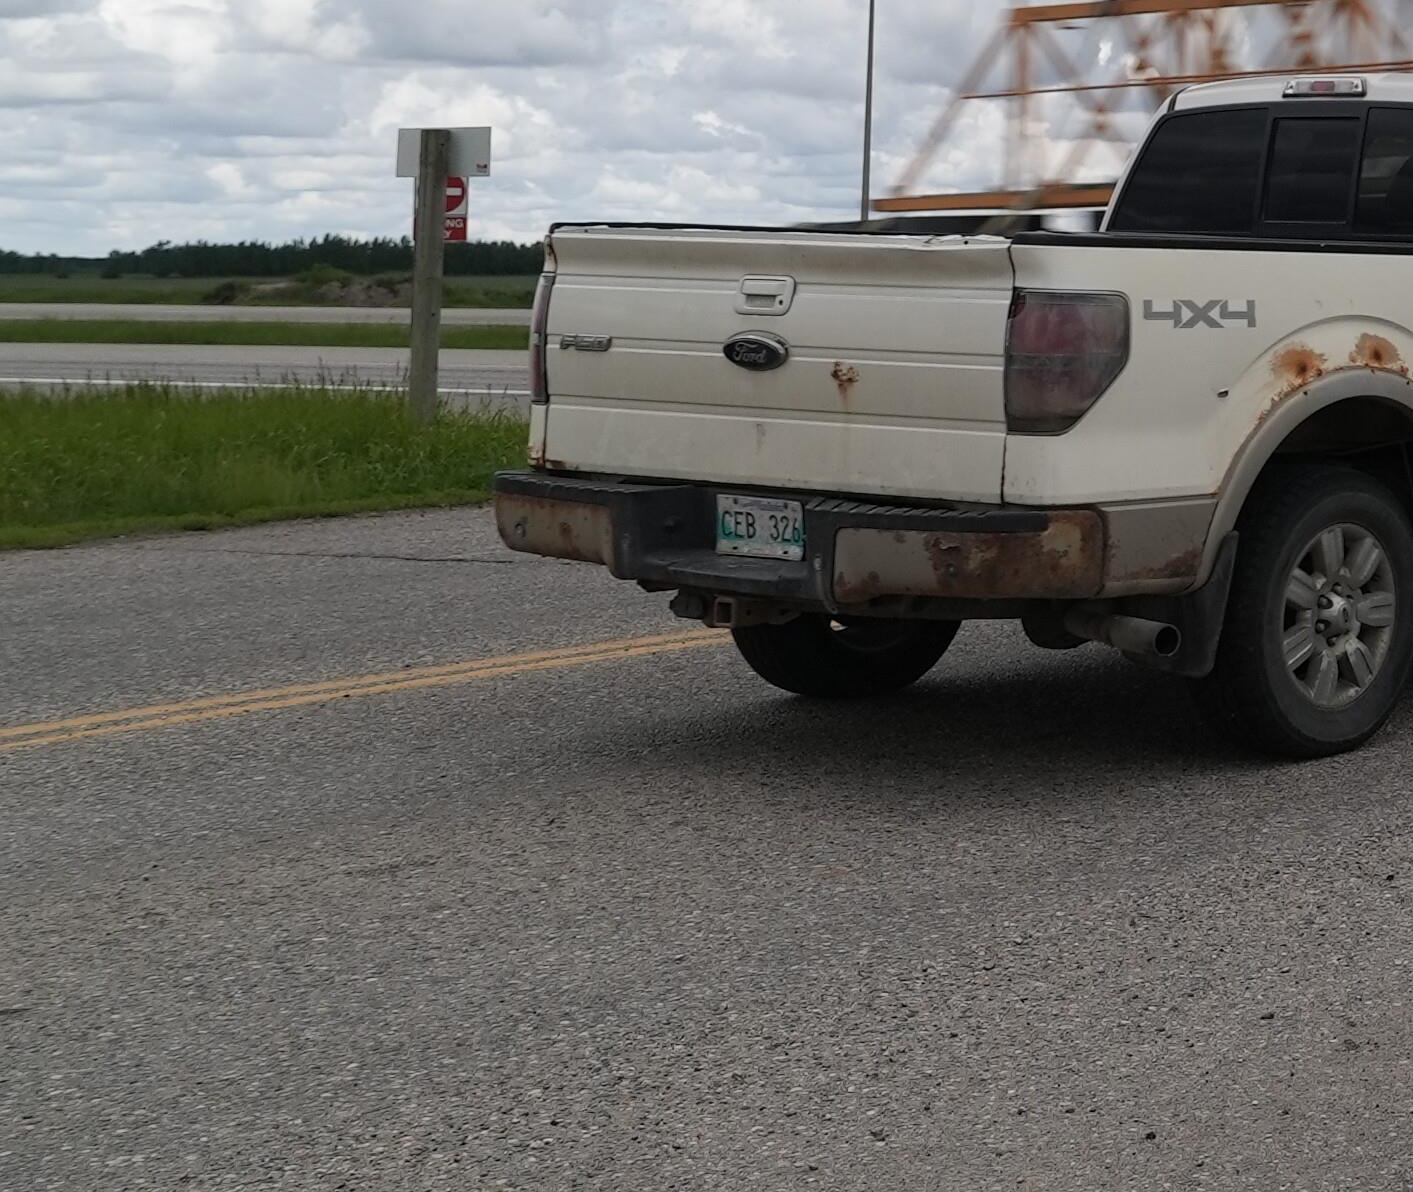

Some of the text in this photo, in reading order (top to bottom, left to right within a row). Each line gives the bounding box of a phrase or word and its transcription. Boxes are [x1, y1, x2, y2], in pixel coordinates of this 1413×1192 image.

[732, 341, 768, 364] Ford
[721, 511, 801, 543] CEB 326
